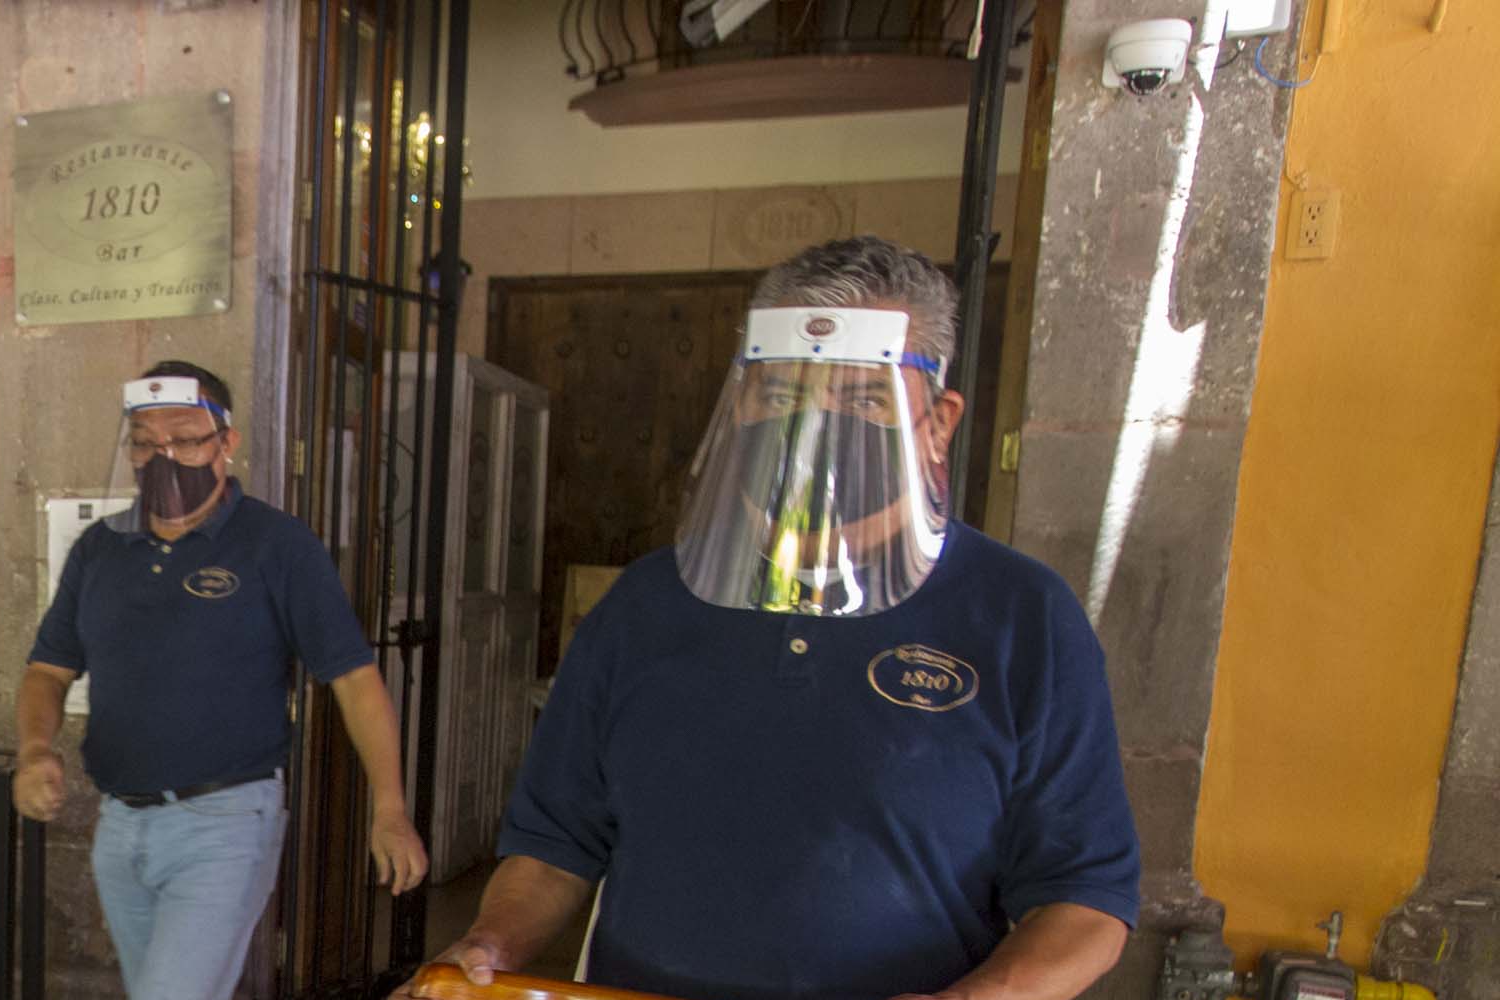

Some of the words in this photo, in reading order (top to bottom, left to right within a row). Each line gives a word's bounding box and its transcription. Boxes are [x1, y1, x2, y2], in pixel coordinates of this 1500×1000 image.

[51, 144, 193, 184] Restaurante
[80, 182, 161, 221] 1810
[96, 243, 144, 263] Bar
[131, 287, 143, 304] y
[901, 669, 950, 691] 1810
